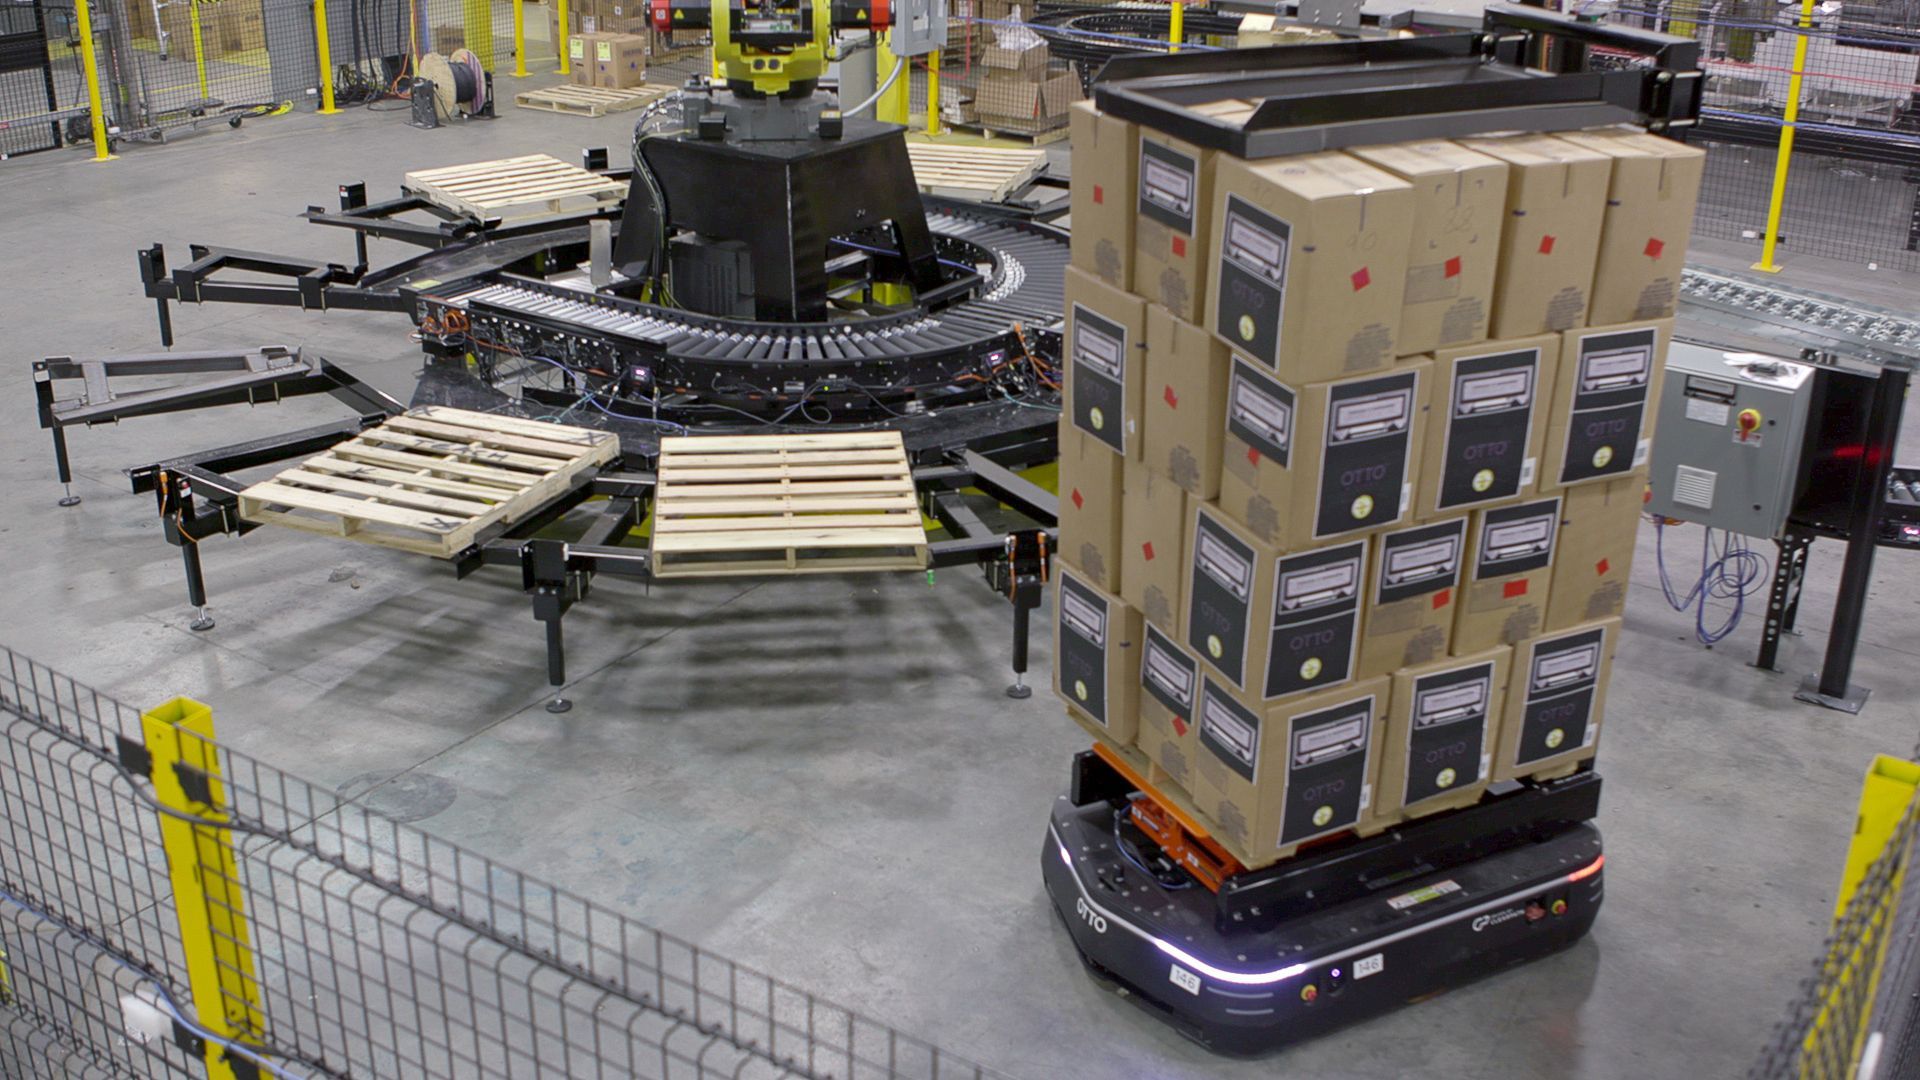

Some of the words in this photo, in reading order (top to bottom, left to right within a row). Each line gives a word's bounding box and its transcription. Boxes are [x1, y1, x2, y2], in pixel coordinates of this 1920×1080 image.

[1586, 418, 1626, 437] OTTO
[1464, 441, 1508, 461] OTTO
[1340, 464, 1386, 487] OTTO
[1289, 628, 1335, 651] OTTO
[1538, 703, 1576, 723] OTTO
[1425, 741, 1467, 764] OTTO
[1302, 779, 1346, 801] OTTO
[1077, 897, 1107, 934] OTTO
[1359, 957, 1380, 974] 146
[1176, 969, 1196, 989] 146
